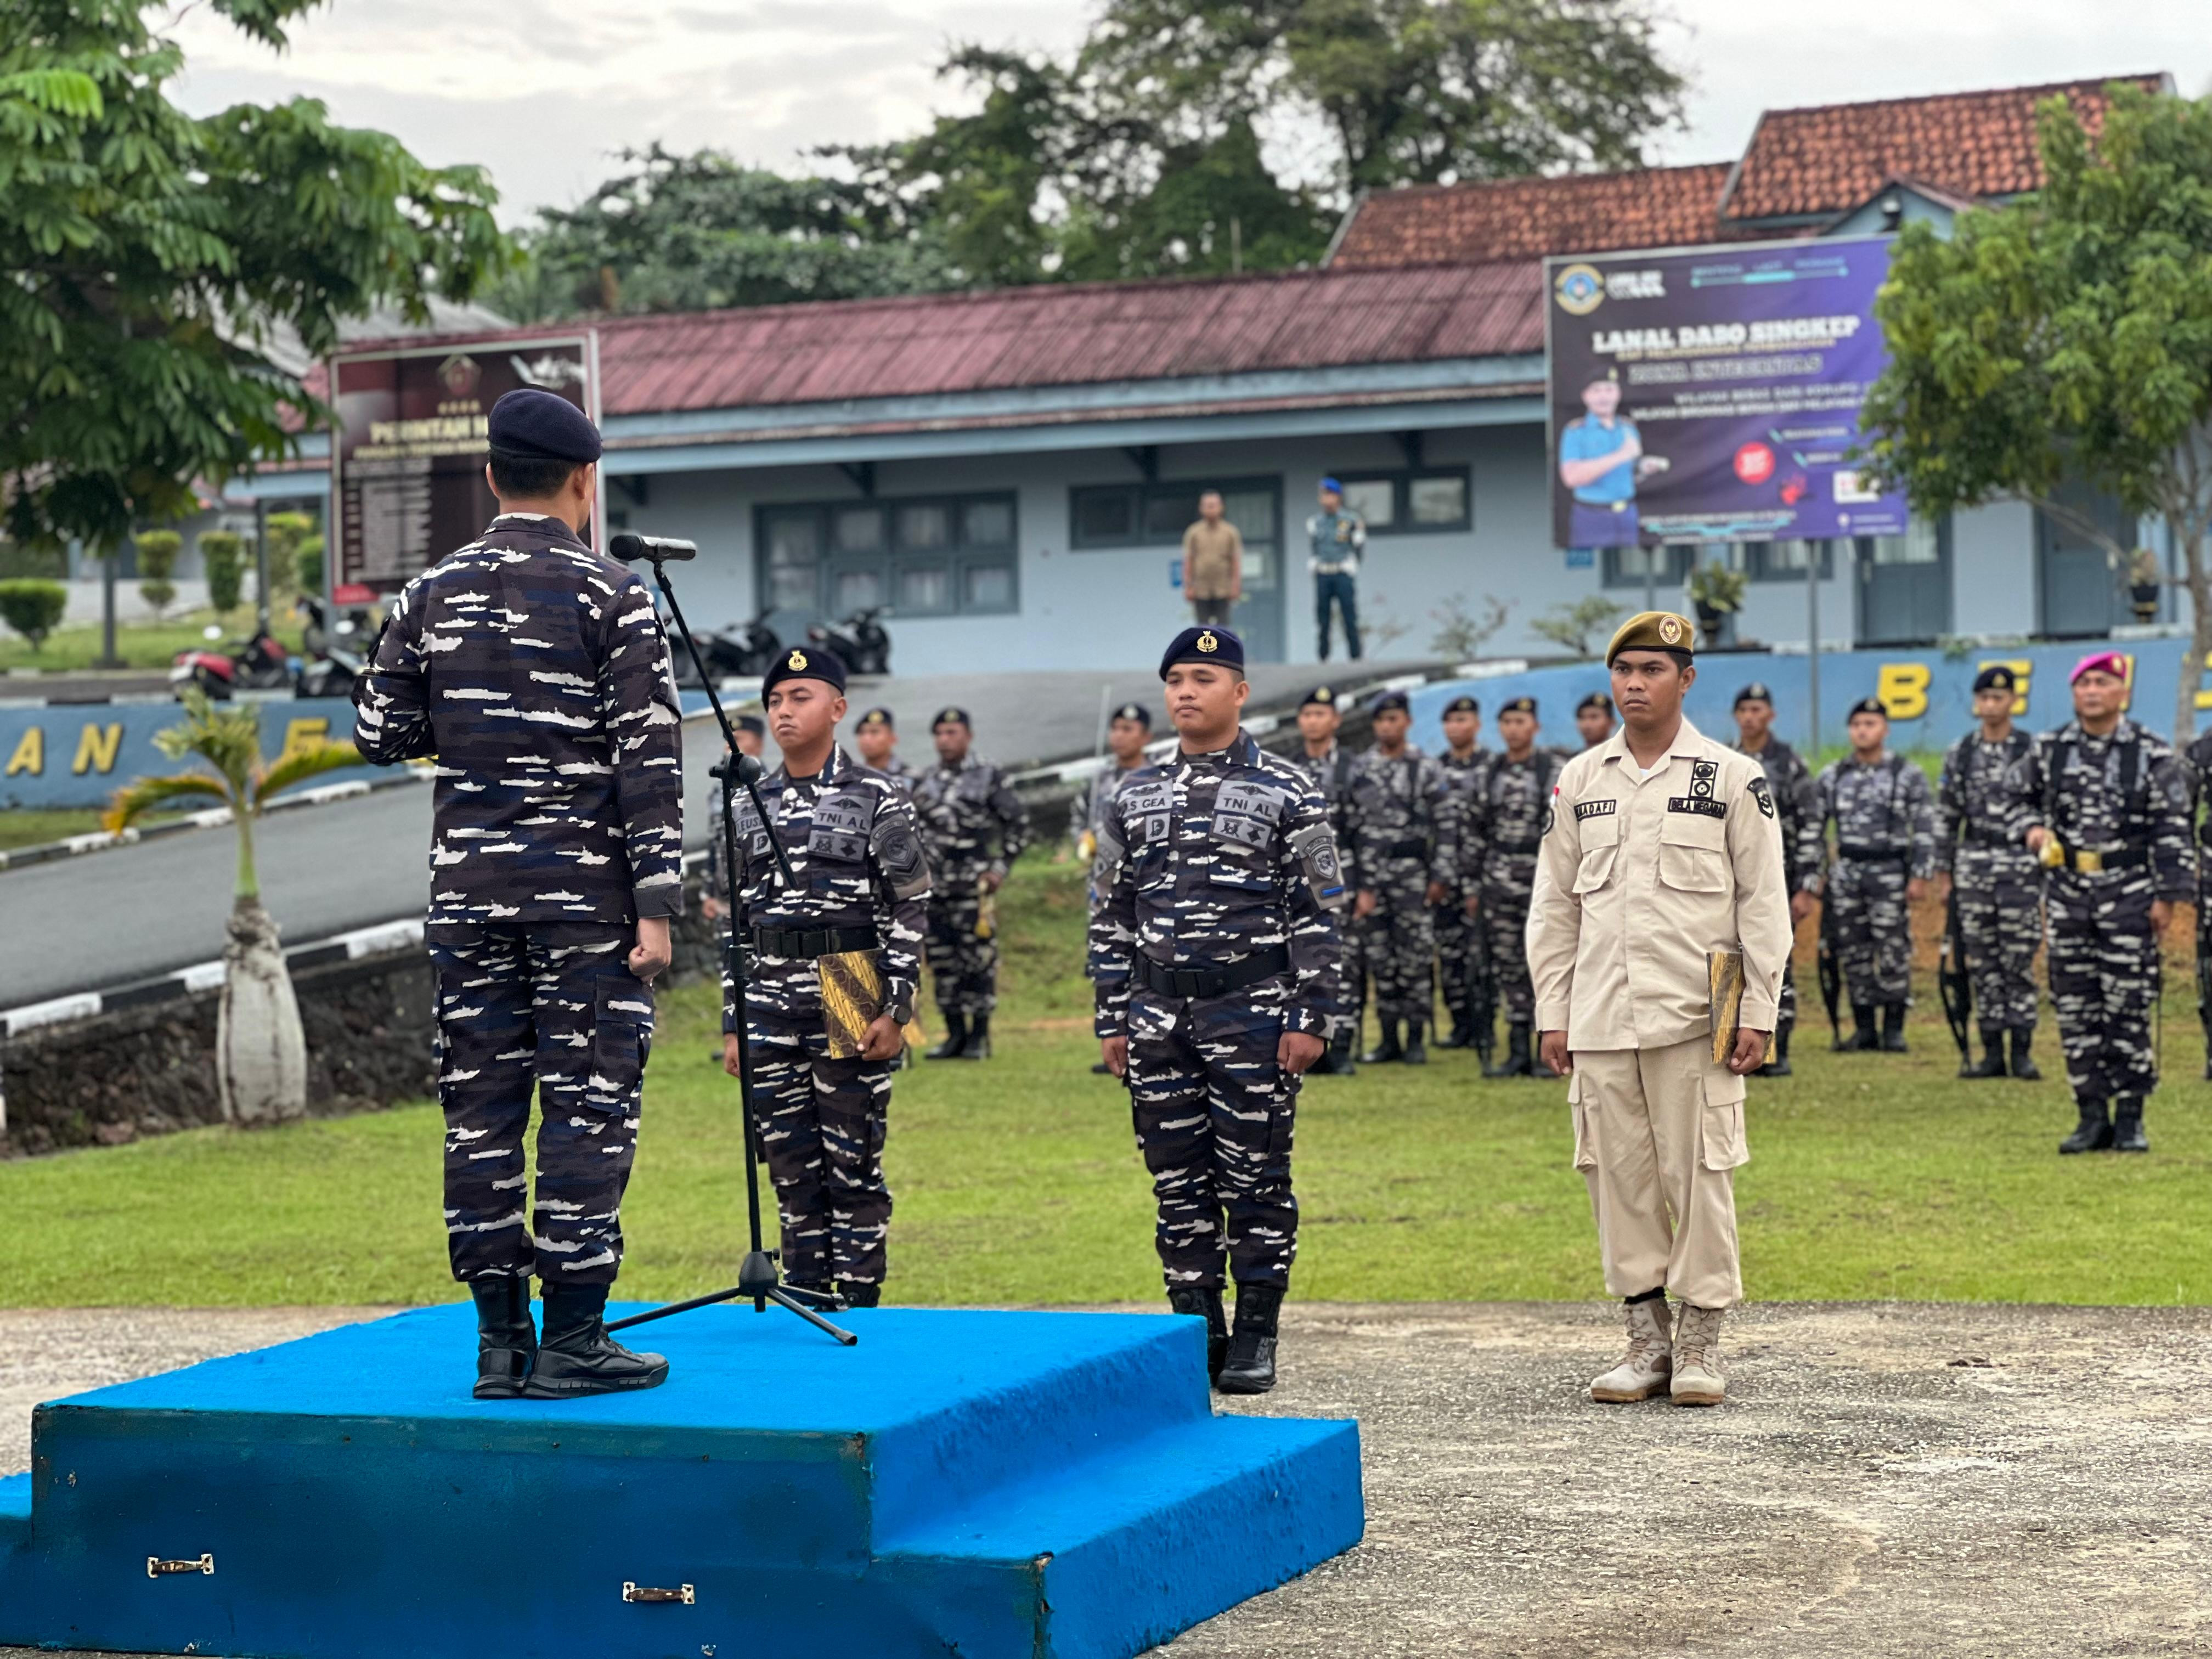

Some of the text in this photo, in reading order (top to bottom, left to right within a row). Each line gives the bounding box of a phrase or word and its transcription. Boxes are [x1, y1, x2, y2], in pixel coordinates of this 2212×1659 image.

[1593, 329, 1675, 353] LANAL
[1142, 797, 1165, 809] GEA
[1223, 797, 1272, 817] TNI AL
[819, 812, 842, 824] TNI
[847, 816, 866, 830] AL
